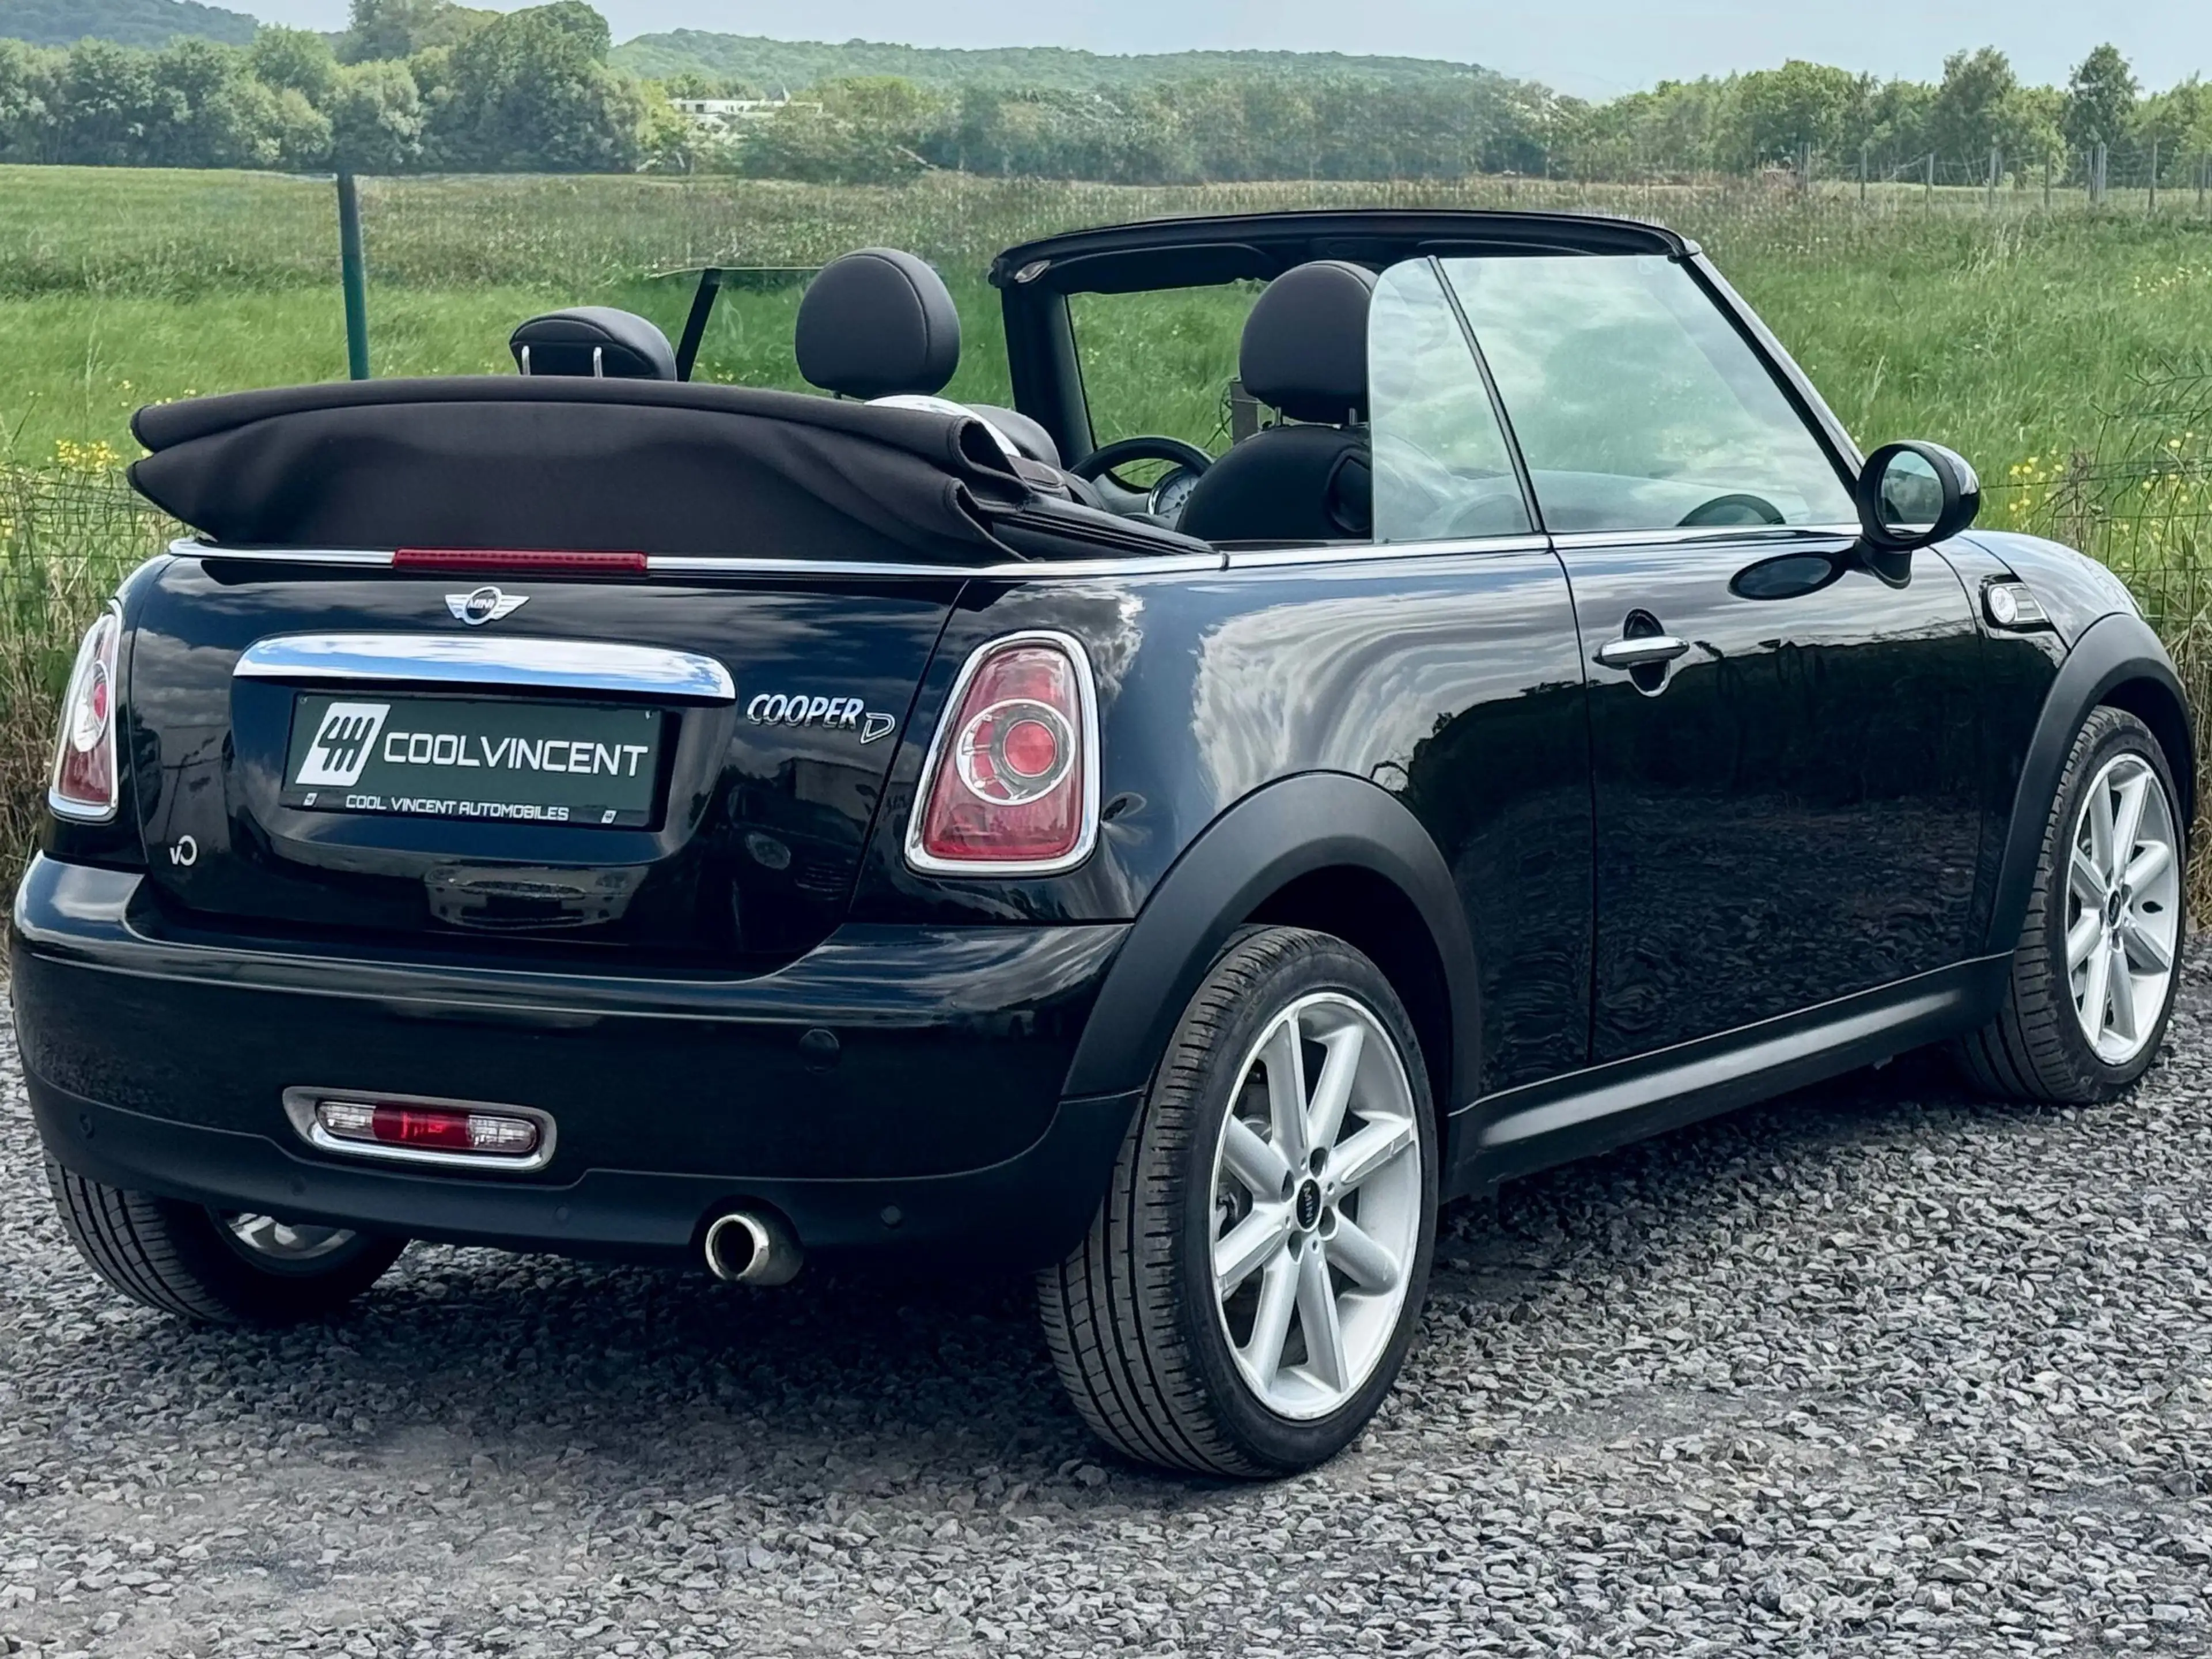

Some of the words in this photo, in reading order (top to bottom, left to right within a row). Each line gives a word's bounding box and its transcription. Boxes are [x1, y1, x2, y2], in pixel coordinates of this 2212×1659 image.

[467, 599, 495, 609] MINI
[747, 694, 864, 729] COOPER
[860, 712, 896, 744] D
[384, 732, 649, 777] COOLVINCENT
[346, 795, 387, 810] COOL
[391, 797, 456, 815] VINCENT
[459, 801, 570, 821] AUTOMOBILES
[1303, 1183, 1314, 1224] MINI
